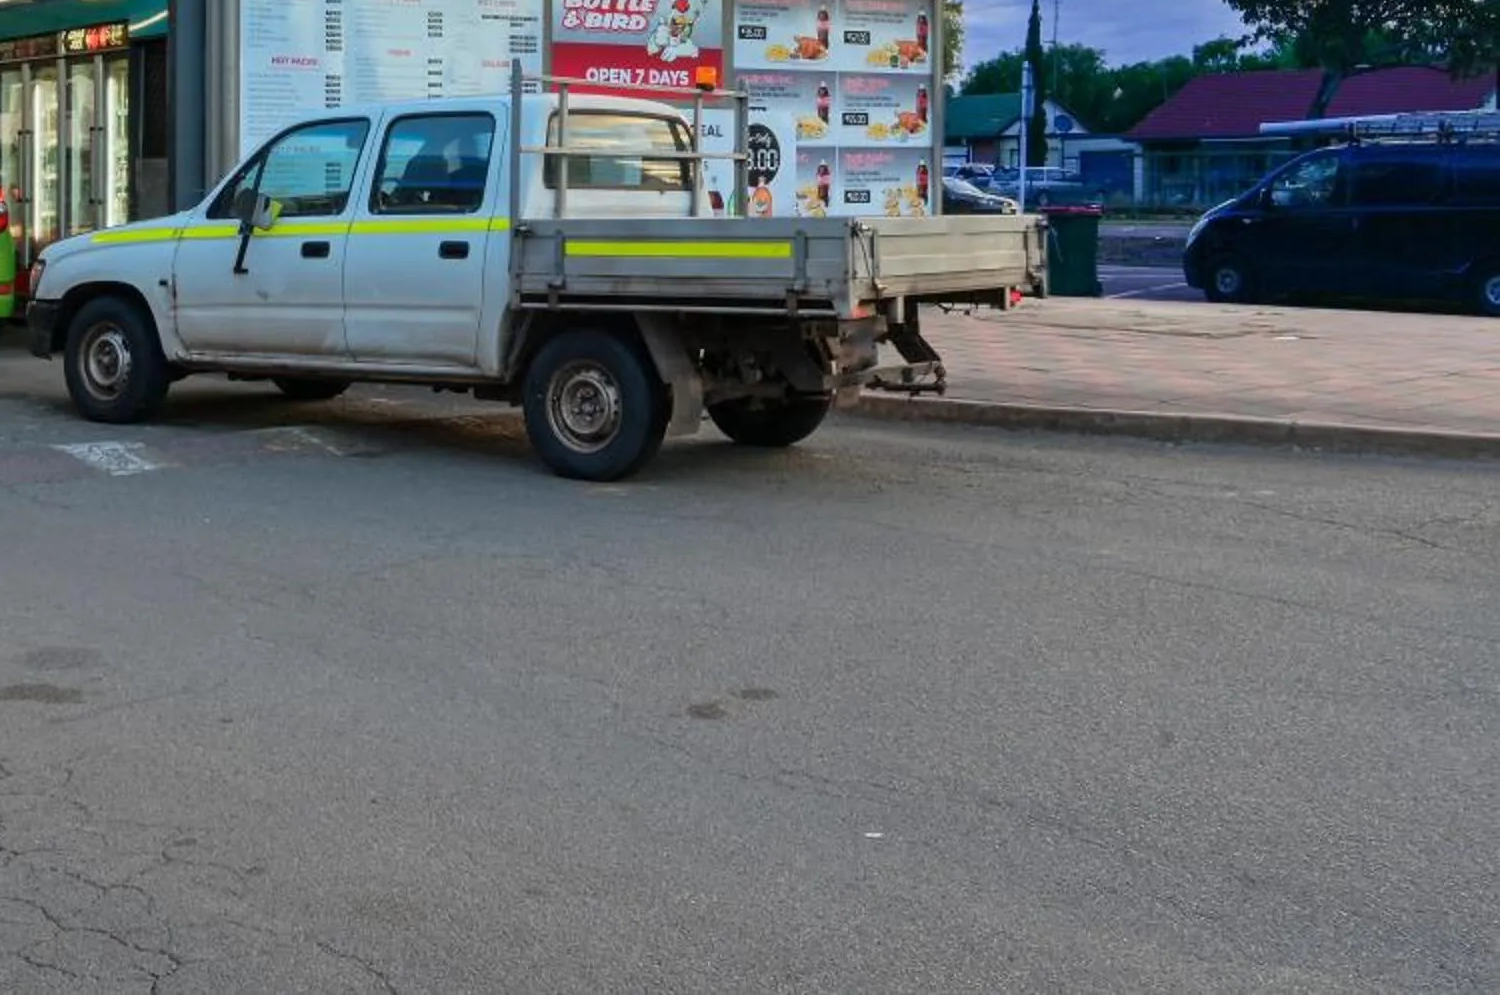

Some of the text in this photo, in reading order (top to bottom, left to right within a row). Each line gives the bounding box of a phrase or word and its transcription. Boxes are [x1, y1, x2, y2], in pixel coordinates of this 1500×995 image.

[563, 10, 648, 31] & BIRD
[586, 67, 689, 86] OPEN 7 DAYS
[701, 124, 724, 137] EAL
